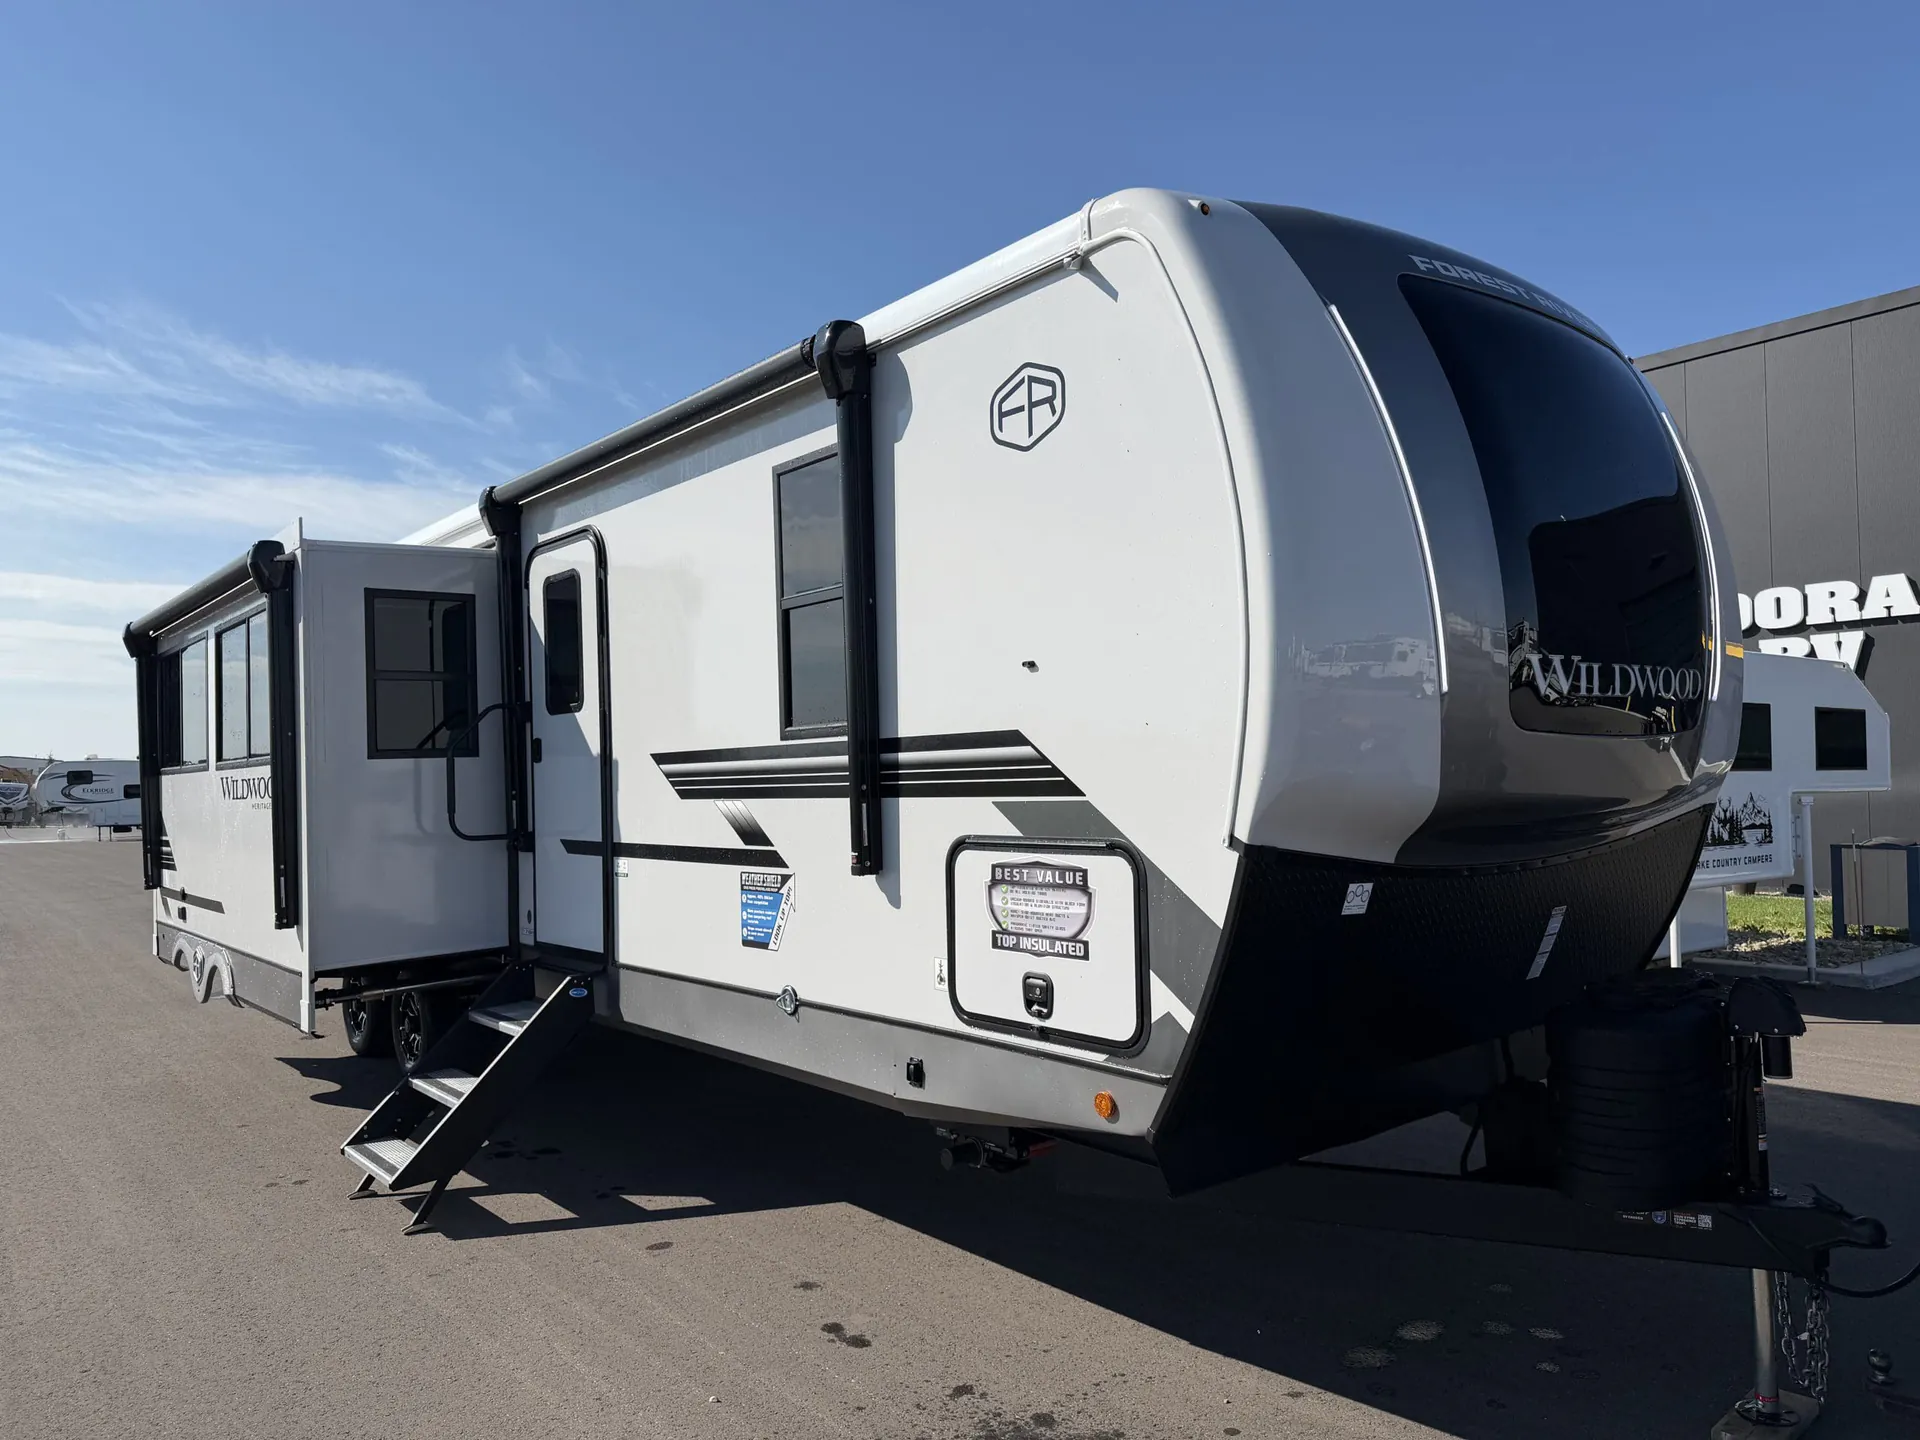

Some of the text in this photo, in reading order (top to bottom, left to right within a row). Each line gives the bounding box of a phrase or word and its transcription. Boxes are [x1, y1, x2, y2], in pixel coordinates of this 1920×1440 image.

[1408, 254, 1531, 300] FOREST
[1526, 653, 1702, 700] WILDWOOD
[220, 776, 272, 800] WILDWOO
[1696, 854, 1773, 869] AKE COUNTRY CAMPERS
[995, 867, 1084, 885] BEST VALUE
[773, 887, 792, 945] LOOK UP TOP!
[996, 933, 1085, 956] TOP INSULATED
